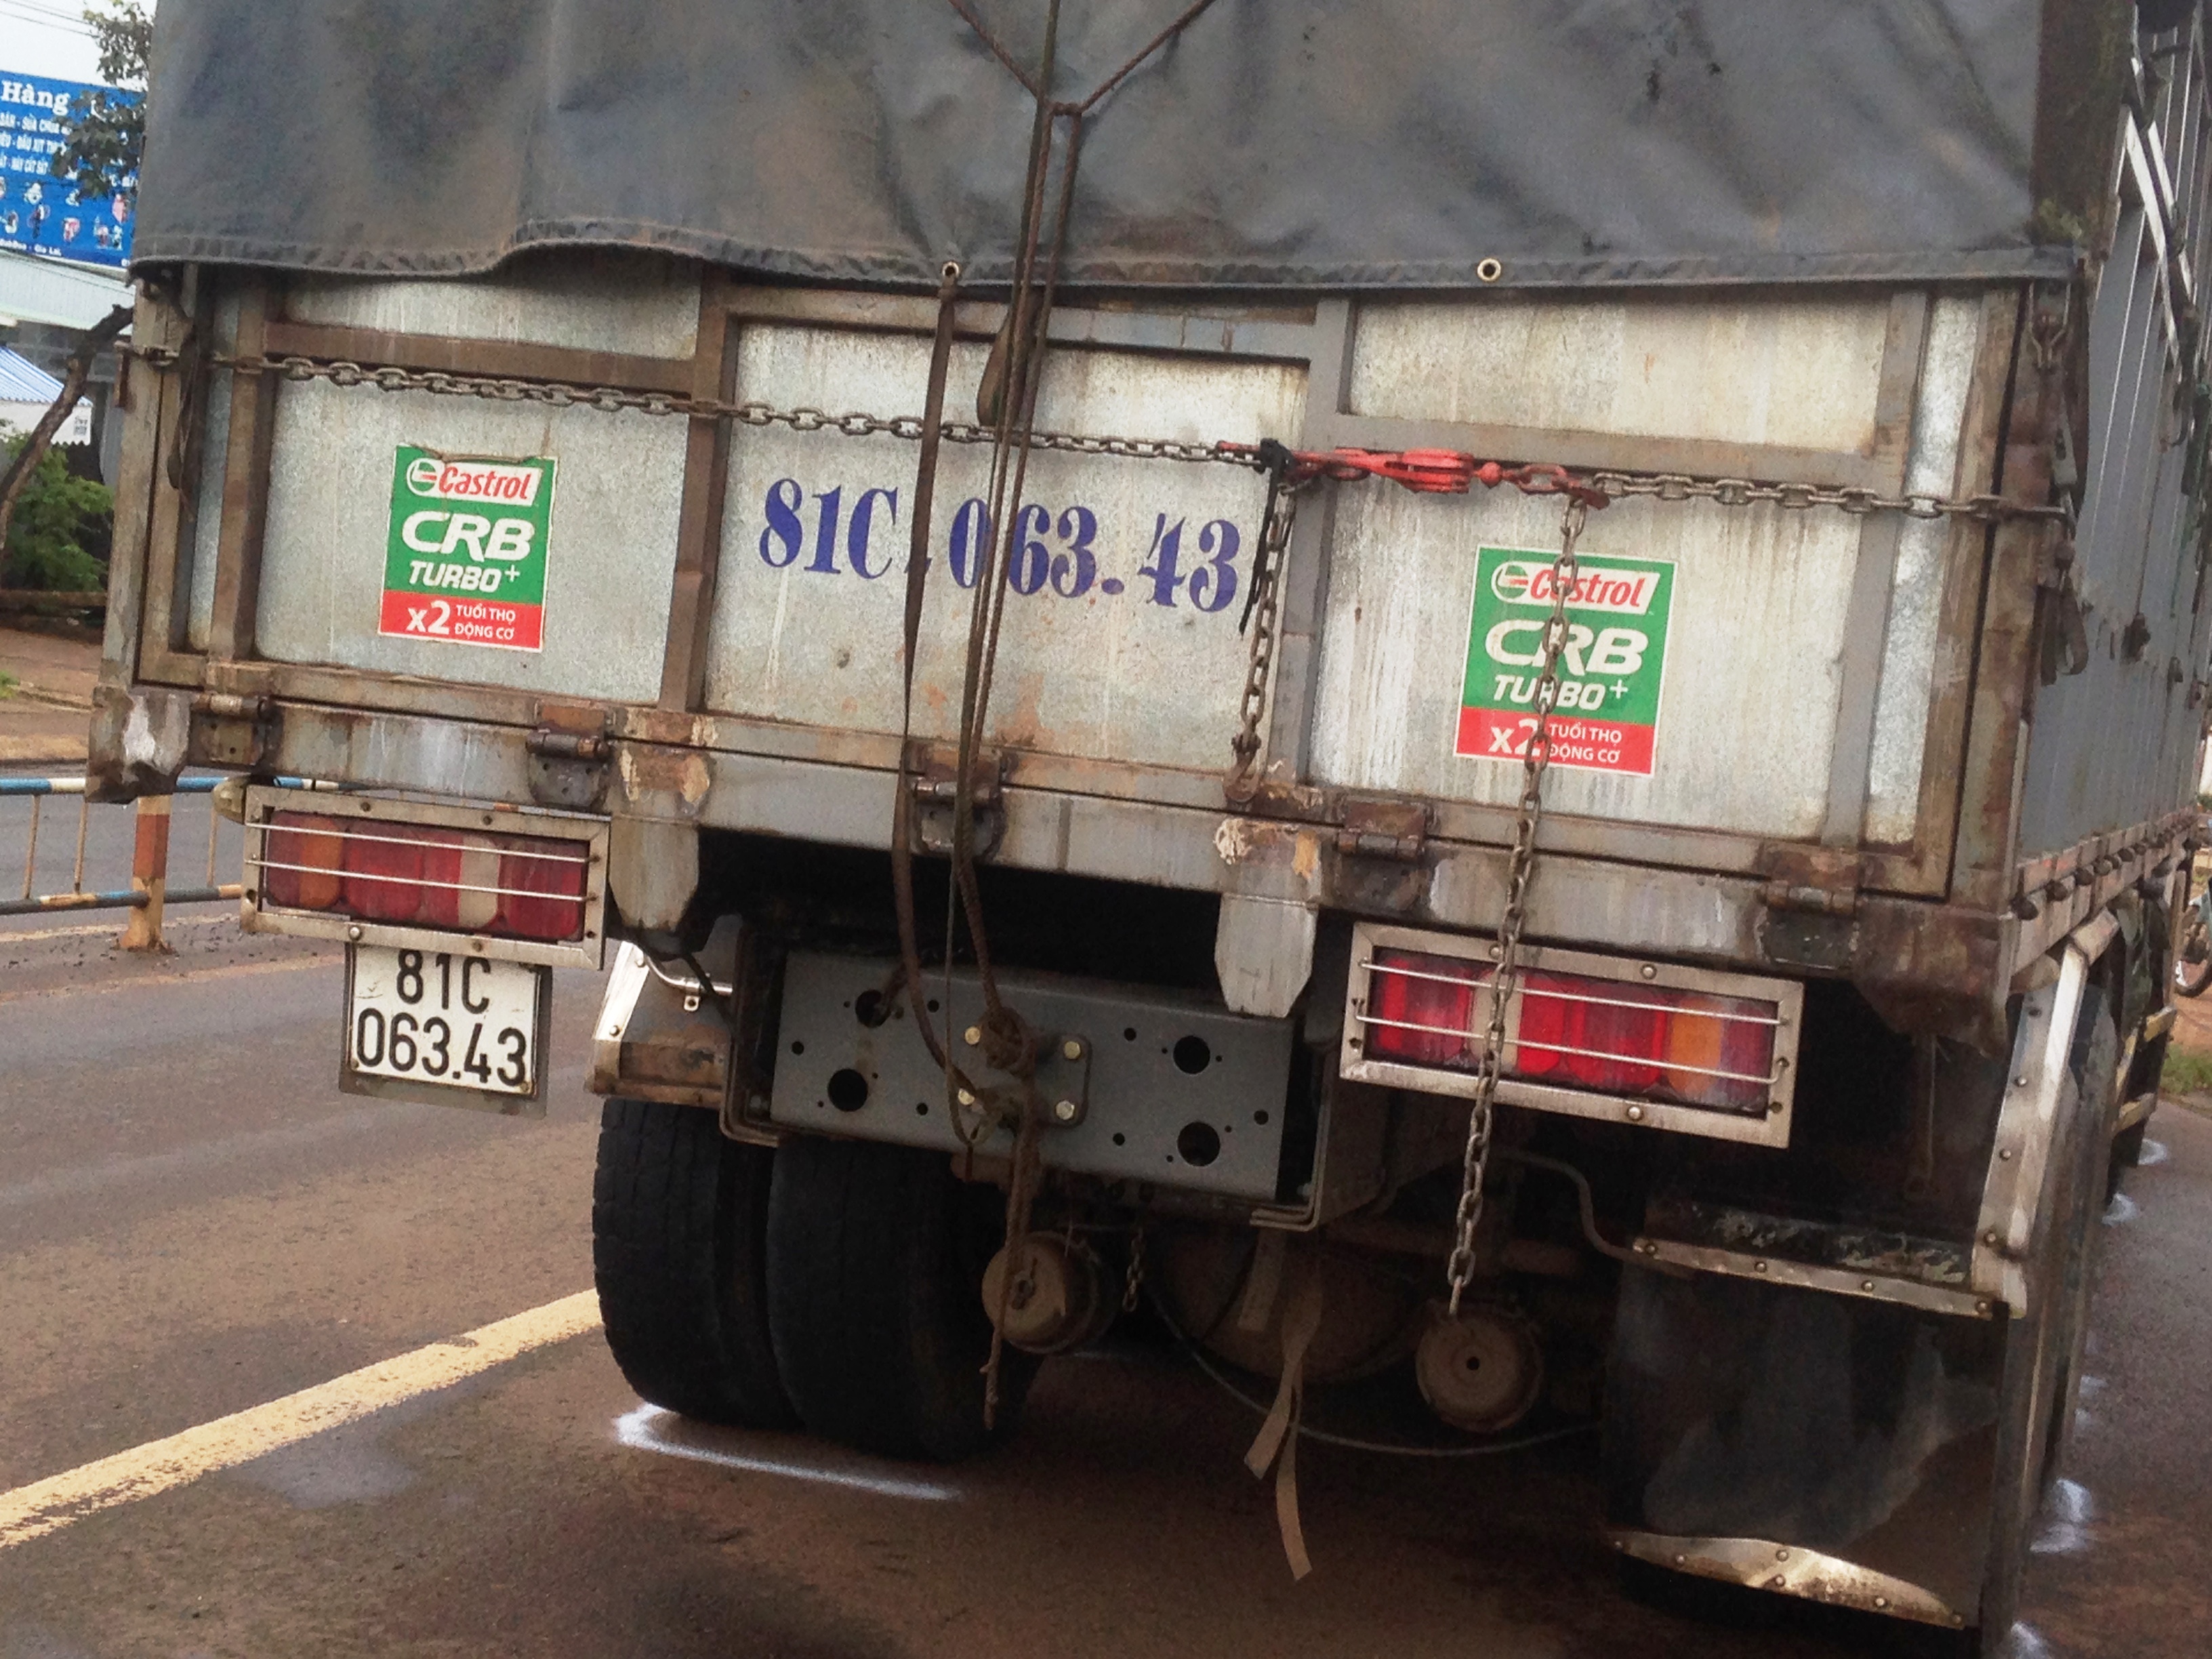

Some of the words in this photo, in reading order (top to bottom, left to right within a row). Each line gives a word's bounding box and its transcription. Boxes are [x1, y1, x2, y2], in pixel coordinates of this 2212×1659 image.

[1, 80, 70, 116] Hàng
[438, 466, 532, 499] Castrol
[402, 510, 535, 562] CRB
[407, 600, 451, 636] x2
[454, 621, 493, 639] ĐỘNG
[496, 626, 515, 640] CƠ
[456, 602, 487, 620] TUỔI
[490, 607, 516, 626] THỌ
[1486, 619, 1649, 676] CRB
[1488, 718, 1541, 757] x2
[1549, 721, 1586, 740] TUỔI
[1589, 727, 1622, 747] THỌ
[1597, 748, 1621, 764] CƠ
[396, 949, 491, 1014] 81C
[356, 1008, 527, 1086] 063.43
